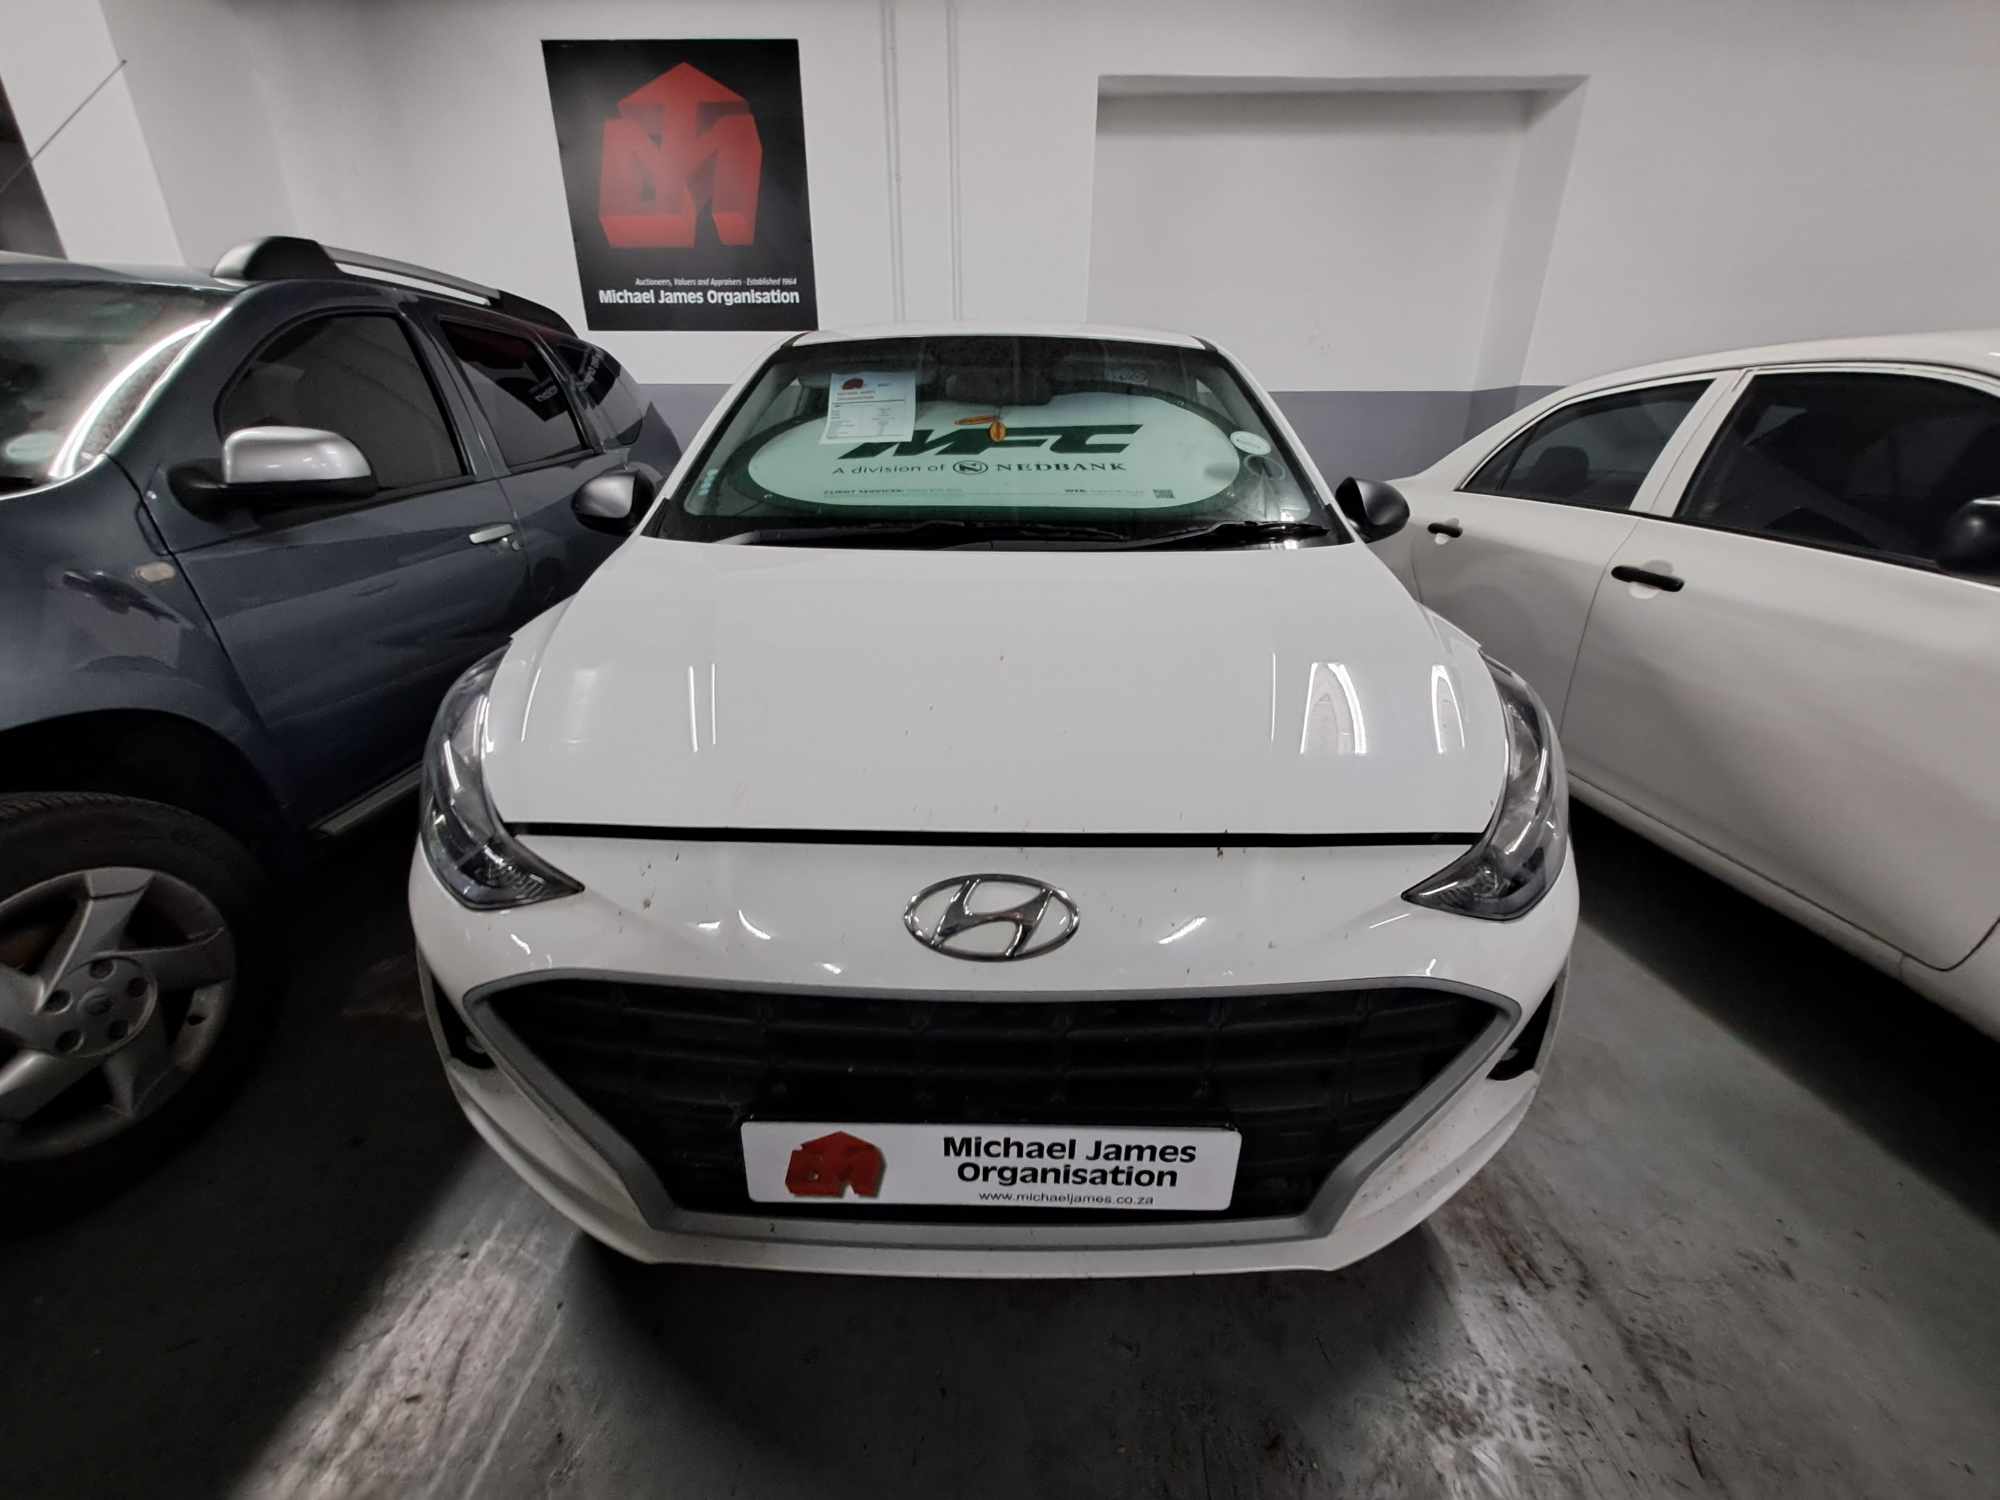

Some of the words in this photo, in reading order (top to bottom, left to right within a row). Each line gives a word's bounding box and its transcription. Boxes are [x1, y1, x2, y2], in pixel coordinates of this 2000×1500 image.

[697, 278, 709, 286] and
[746, 277, 780, 286] Established
[598, 289, 655, 304] Michael
[658, 289, 704, 304] James
[707, 289, 800, 306] Organisation
[832, 466, 845, 475] A
[851, 464, 921, 475] division
[927, 463, 945, 473] of
[997, 462, 1127, 472] NEDBANK
[943, 1136, 1077, 1160] Michael
[1086, 1139, 1197, 1164] James
[957, 1161, 1178, 1188] Organisation
[978, 1190, 1154, 1206] www.michaeljames.co.za
